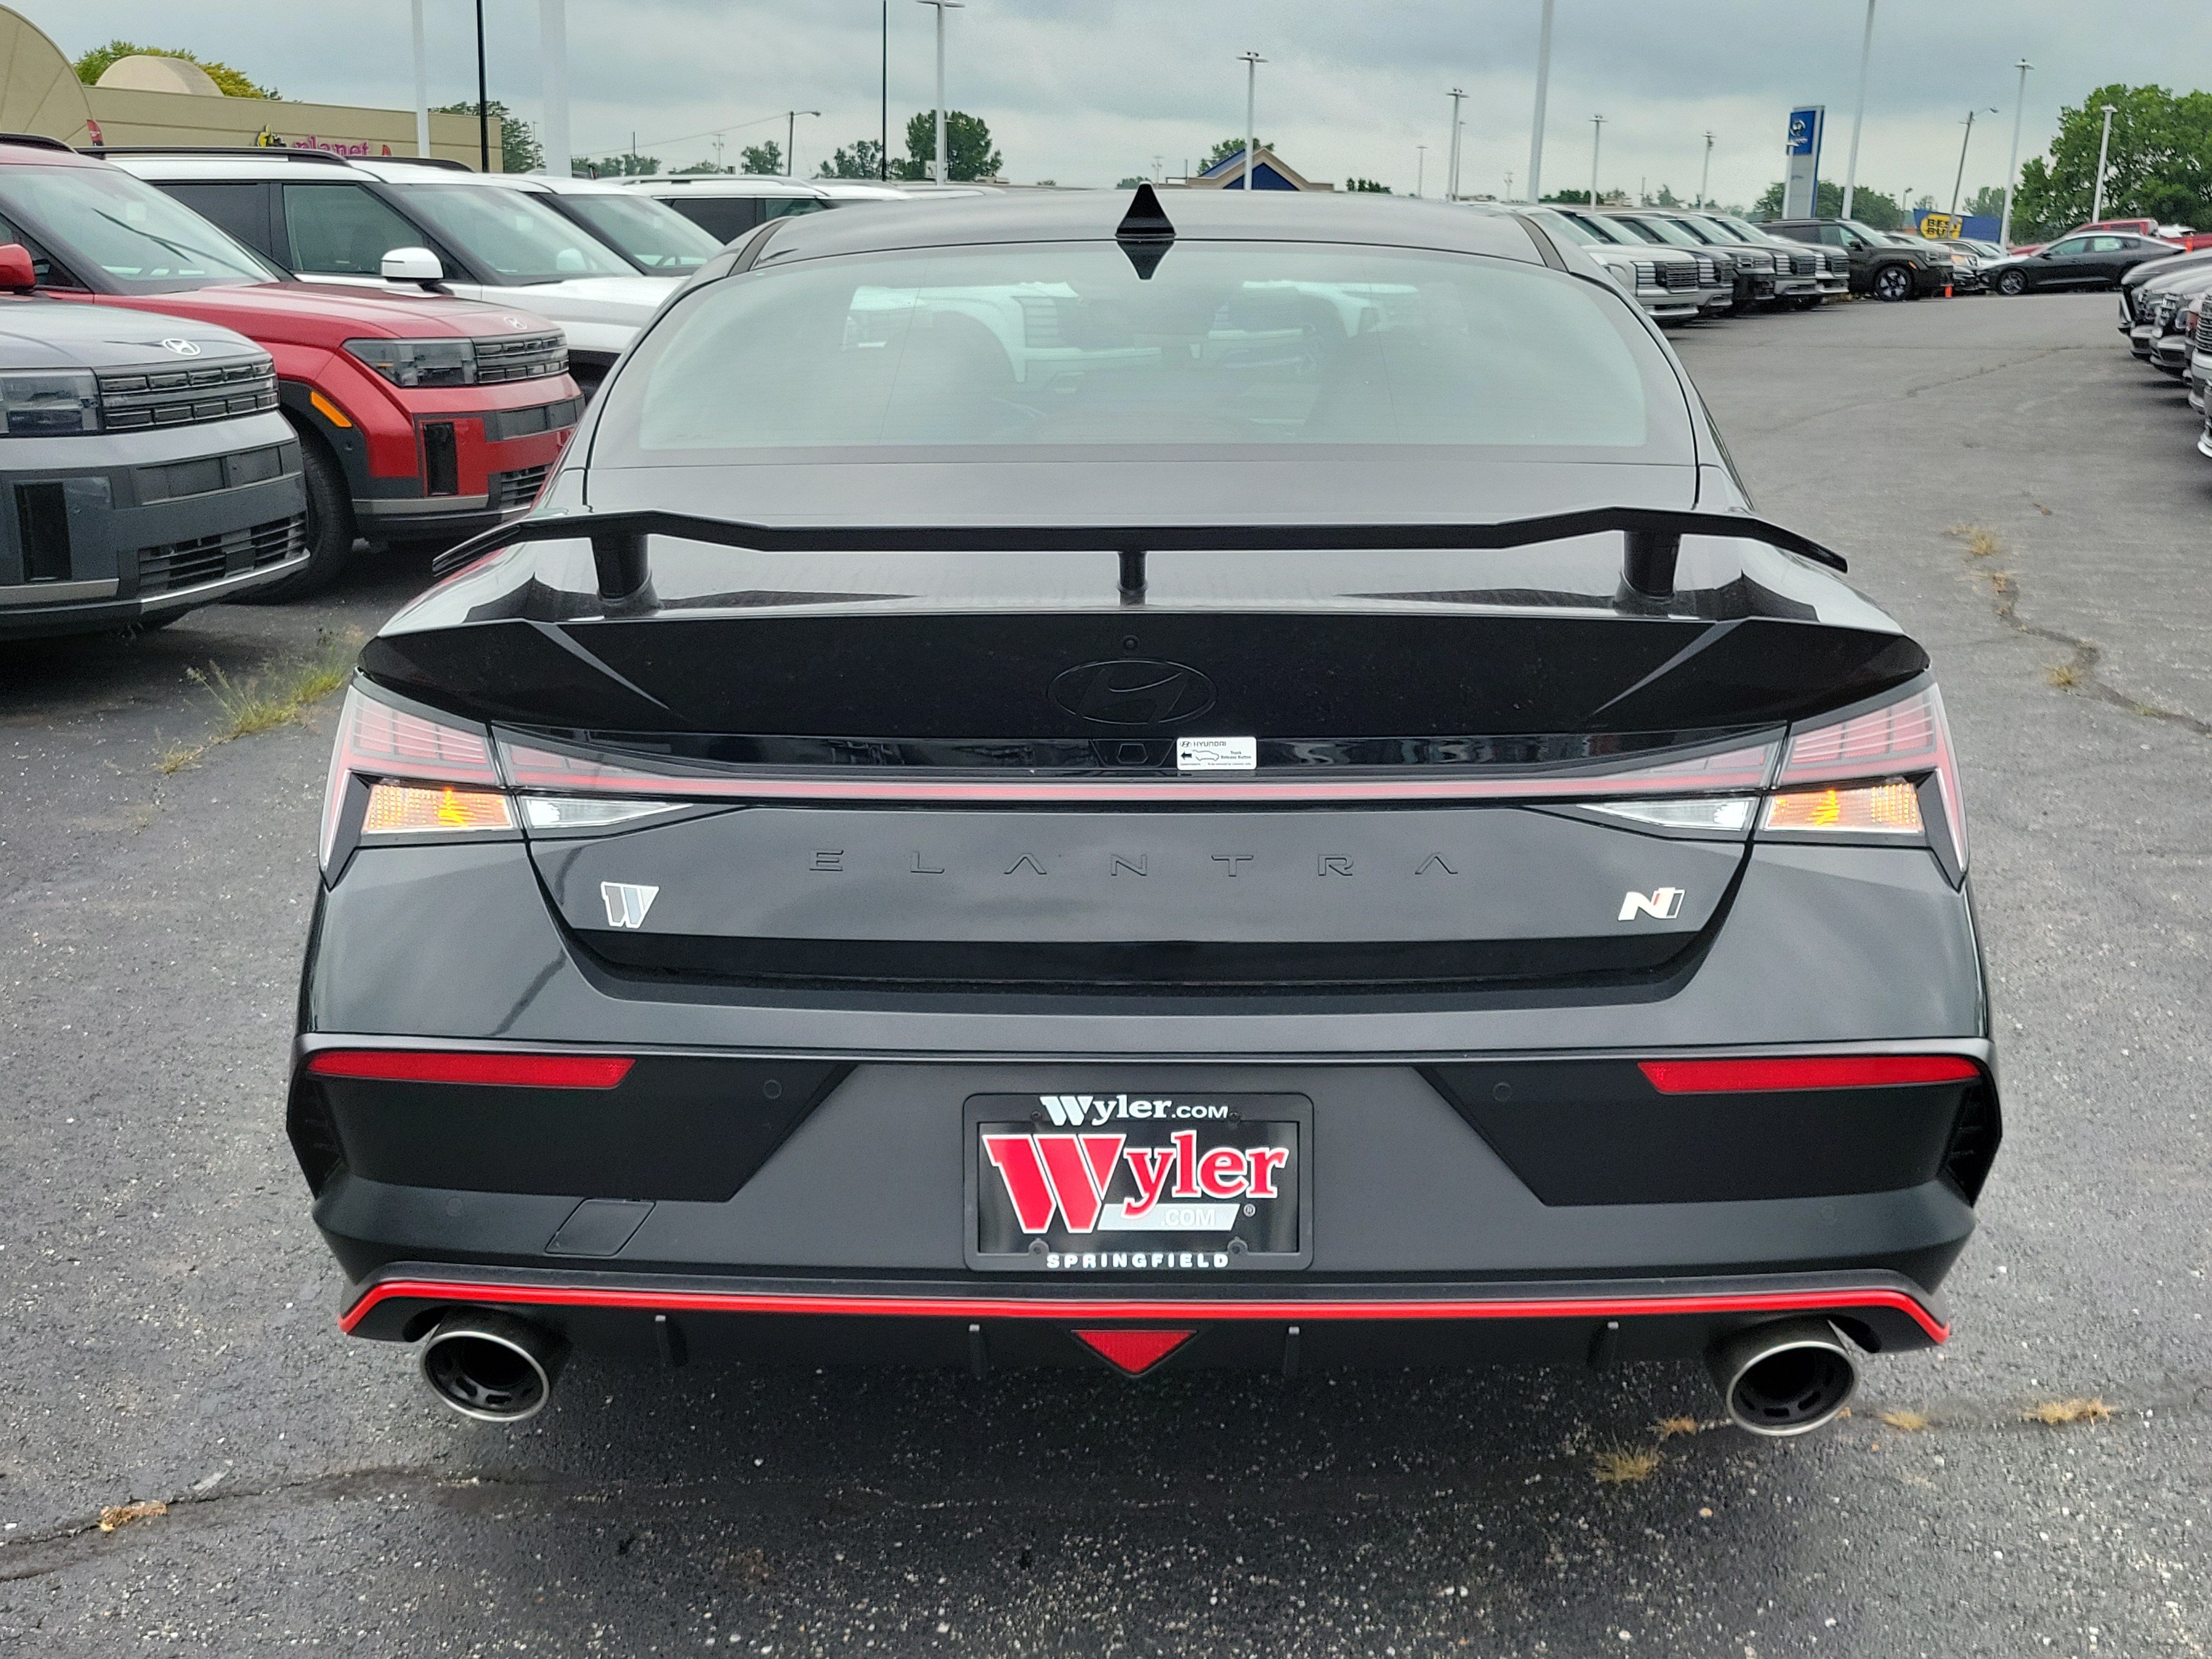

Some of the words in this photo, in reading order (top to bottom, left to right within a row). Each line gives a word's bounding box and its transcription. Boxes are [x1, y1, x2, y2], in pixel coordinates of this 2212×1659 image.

[808, 849, 1459, 877] ELANTRA
[981, 1130, 1289, 1234] Wyler
[1046, 1252, 1229, 1268] SPRINGFIELD
